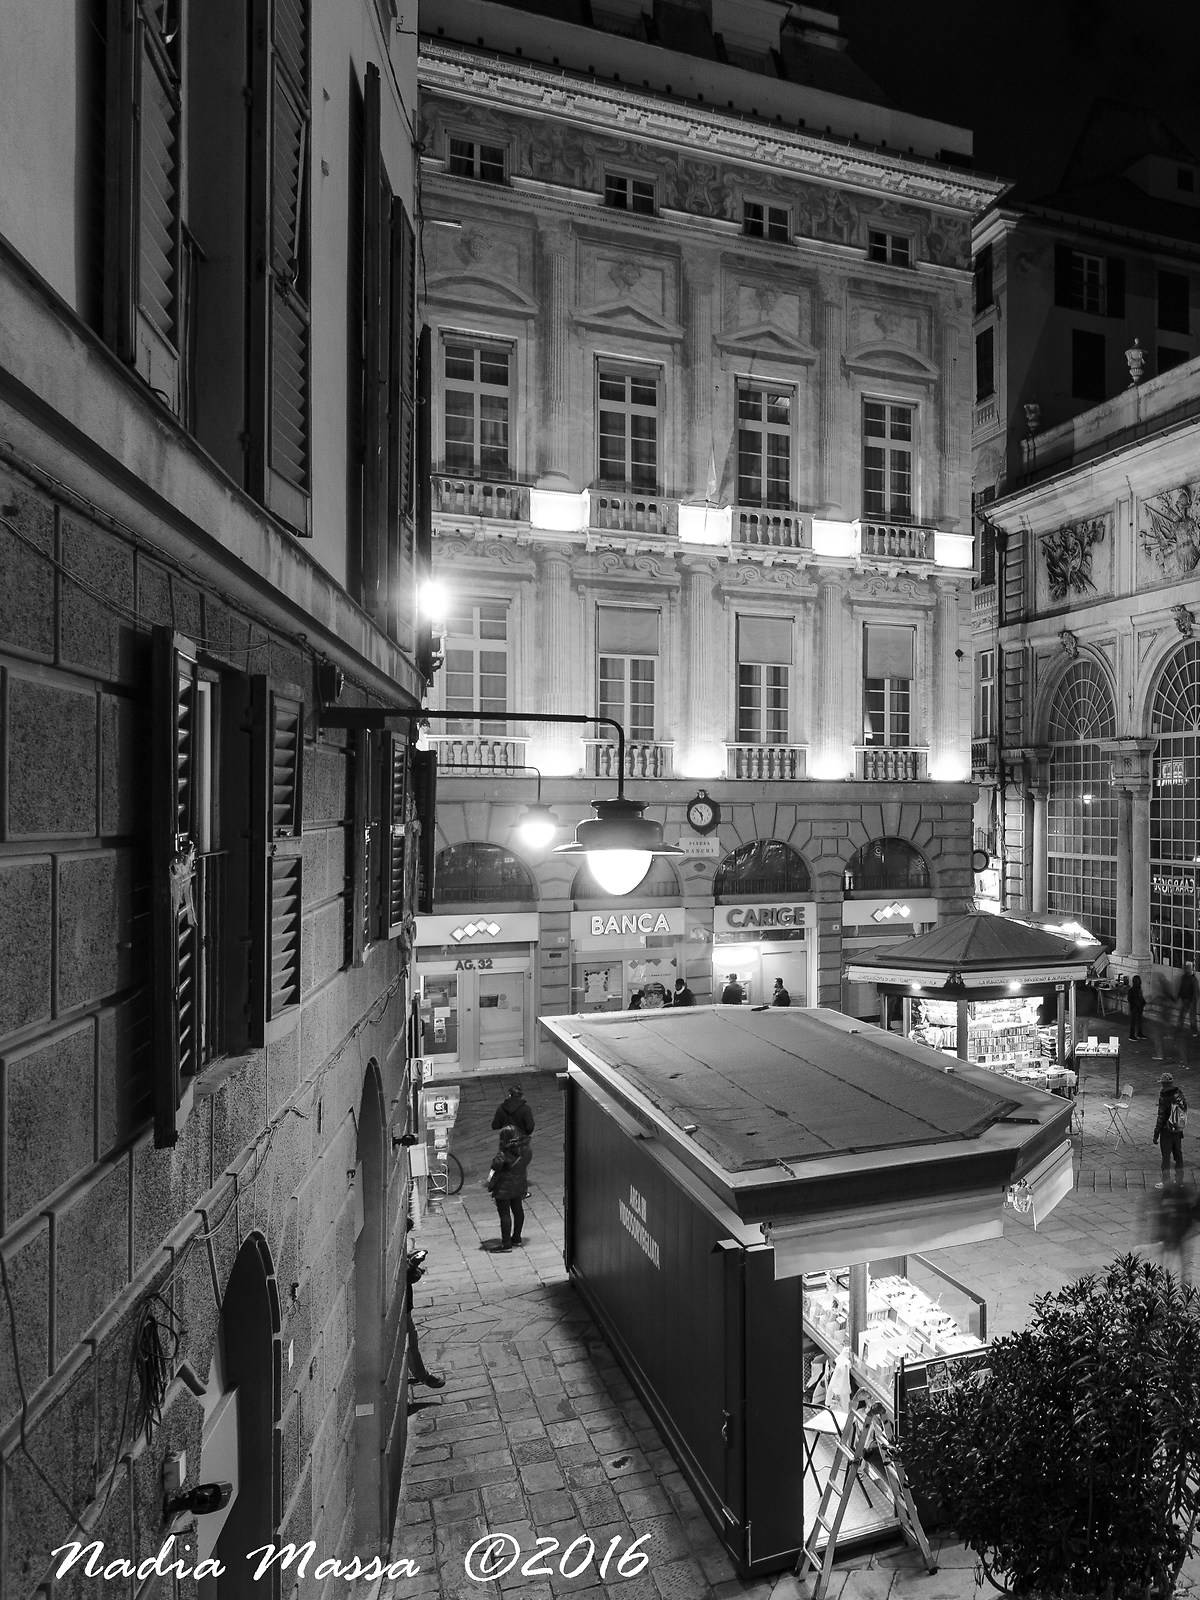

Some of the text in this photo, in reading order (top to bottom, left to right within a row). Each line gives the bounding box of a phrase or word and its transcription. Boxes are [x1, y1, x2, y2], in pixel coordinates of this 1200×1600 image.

[591, 913, 671, 936] BANCA
[726, 906, 806, 928] CARIGE
[455, 958, 494, 970] AG. 32
